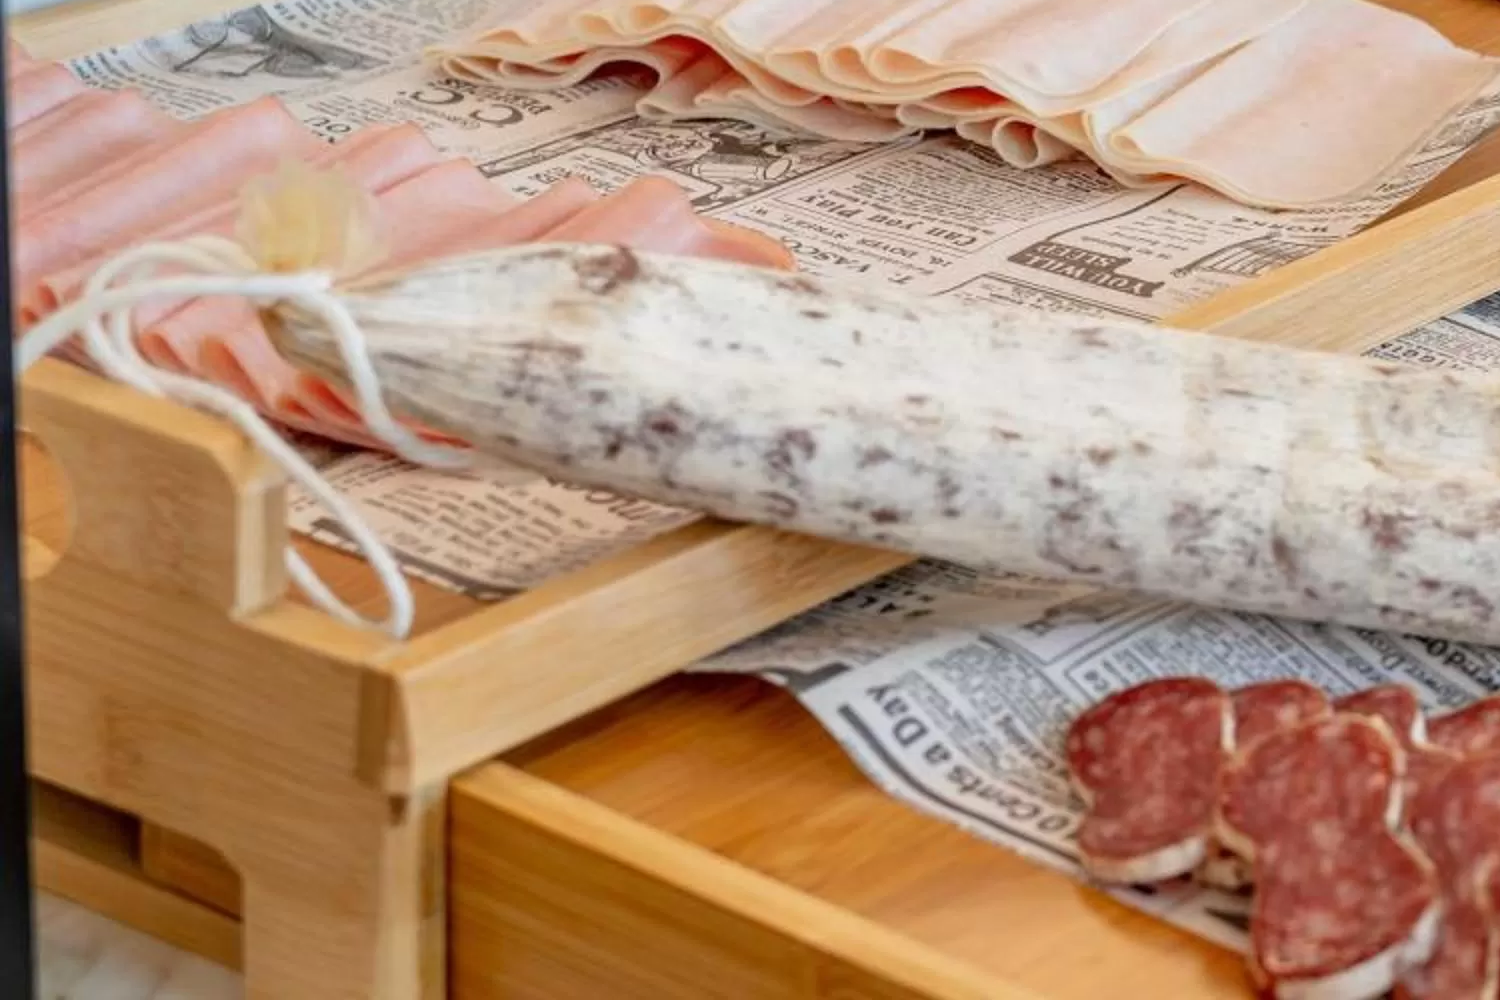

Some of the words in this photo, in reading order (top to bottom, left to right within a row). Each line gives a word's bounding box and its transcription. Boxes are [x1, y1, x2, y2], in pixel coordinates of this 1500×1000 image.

[867, 213, 925, 231] you
[930, 226, 978, 247] Can
[1024, 252, 1087, 279] WILL
[1037, 243, 1117, 267] SLEEP
[1092, 270, 1148, 295] YOU
[864, 682, 930, 747] Day
[922, 741, 952, 766] a
[946, 765, 1042, 820] Cents
